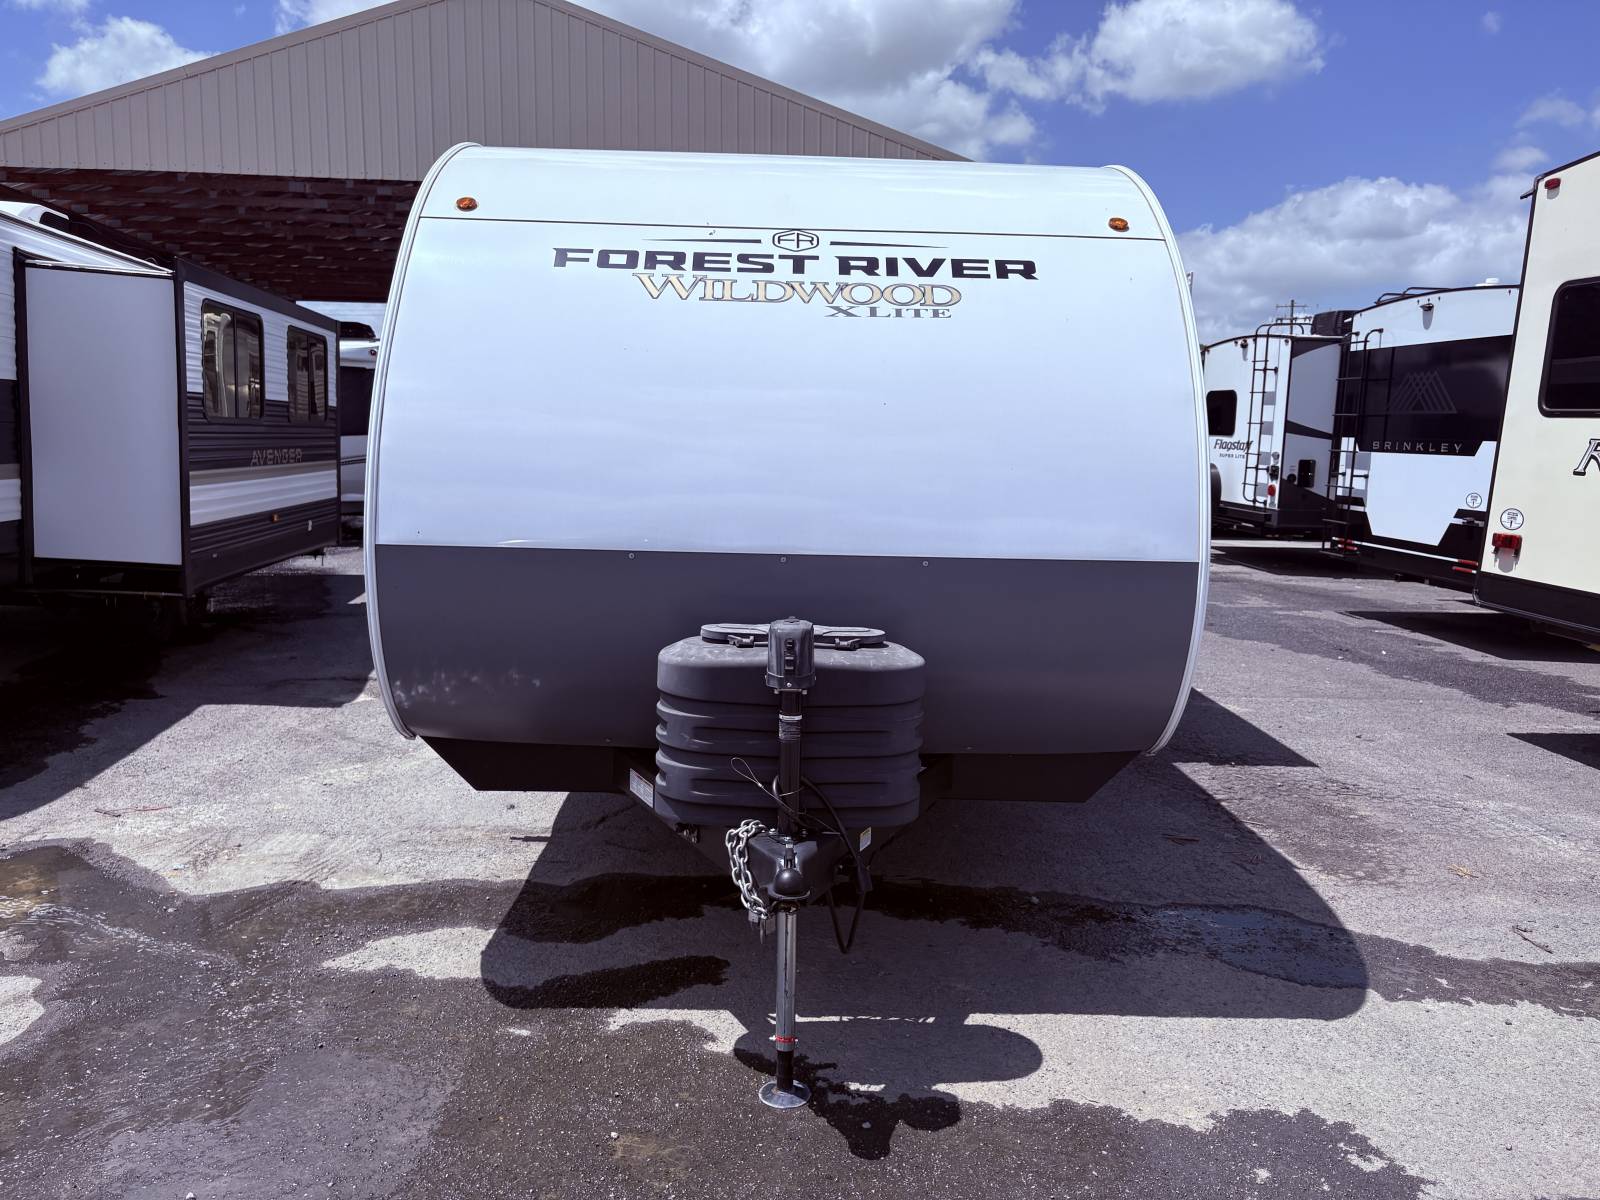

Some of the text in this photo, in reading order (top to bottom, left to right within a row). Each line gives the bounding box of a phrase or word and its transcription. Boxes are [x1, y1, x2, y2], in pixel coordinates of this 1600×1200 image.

[553, 247, 1039, 280] FOREST RIVER
[632, 272, 962, 307] WILDWOOD
[824, 305, 952, 319] X LITE
[1372, 441, 1463, 454] BRINKLEY
[250, 448, 303, 466] AVENGER
